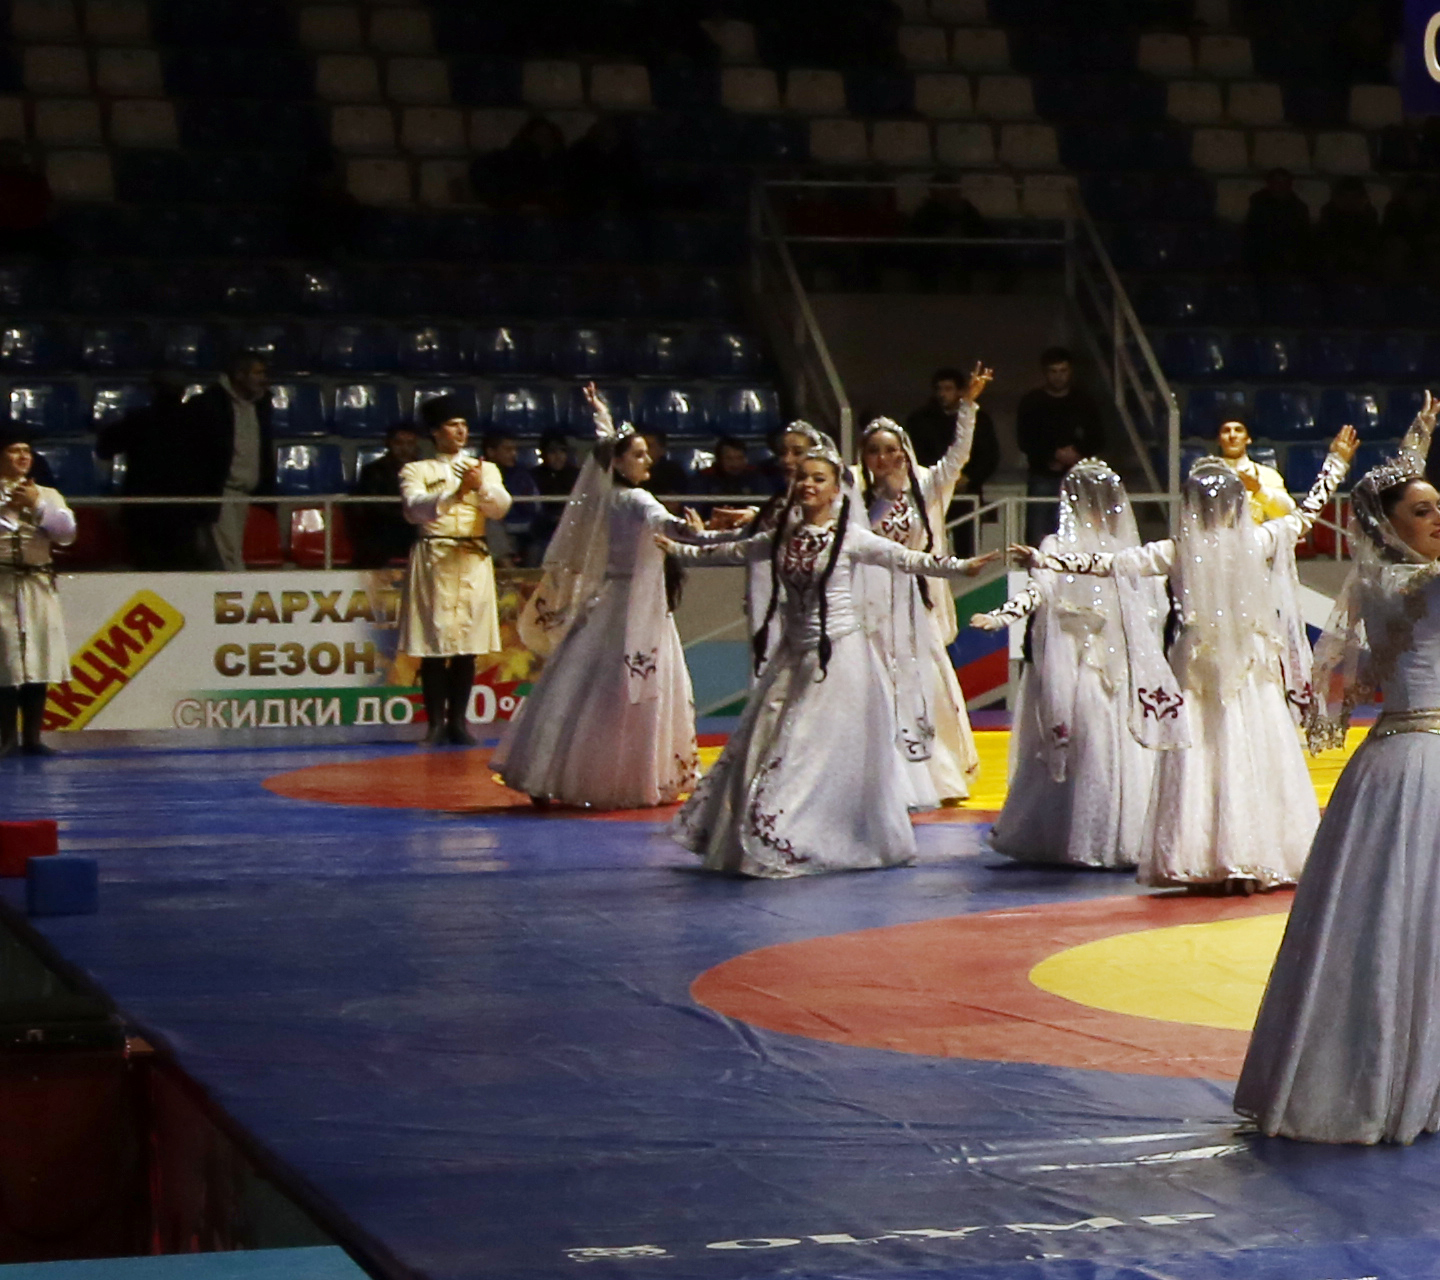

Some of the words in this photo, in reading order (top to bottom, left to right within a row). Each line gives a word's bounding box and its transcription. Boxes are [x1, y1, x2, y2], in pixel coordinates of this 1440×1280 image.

[214, 642, 376, 677] СЕЗОН
[172, 697, 342, 730] СКИДКИ
[353, 696, 414, 727] ДО
